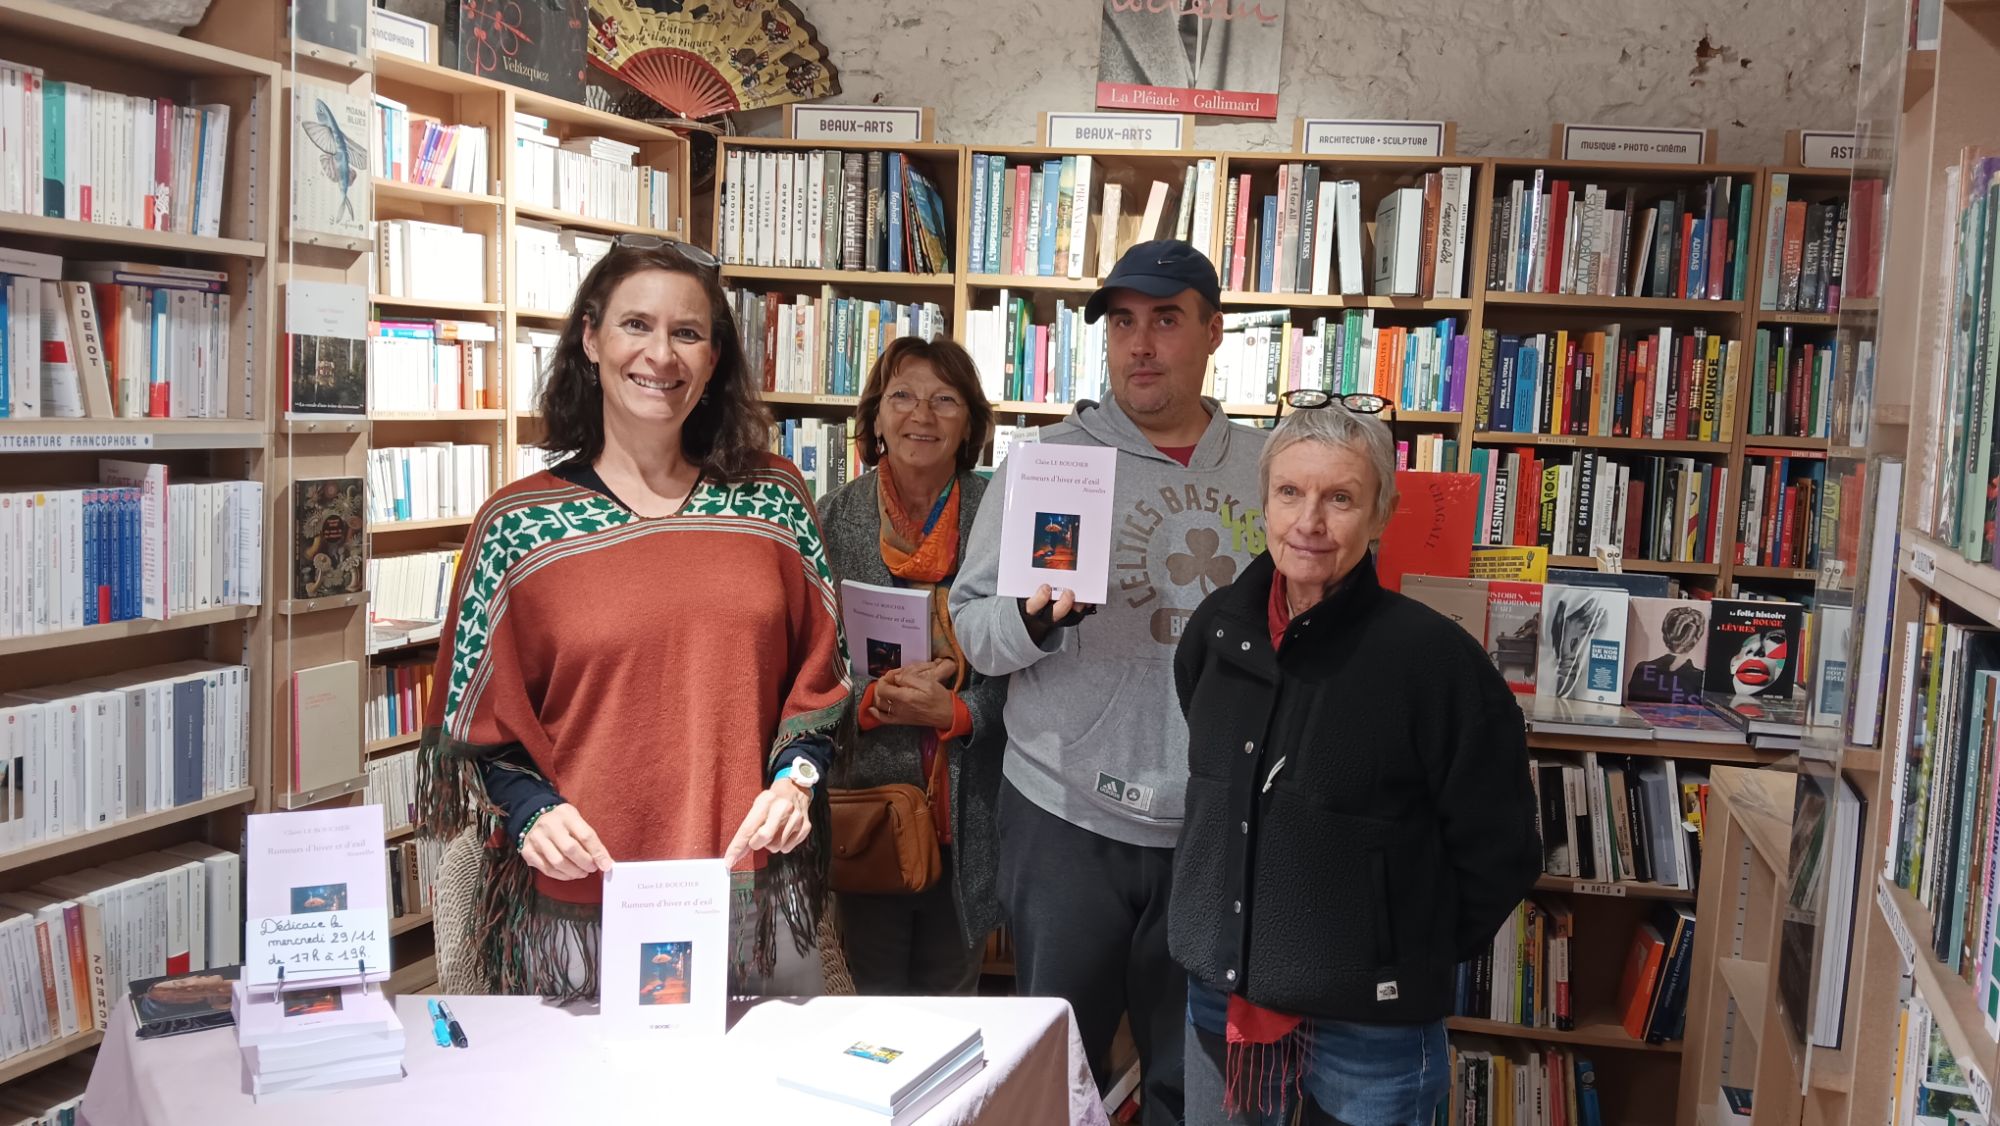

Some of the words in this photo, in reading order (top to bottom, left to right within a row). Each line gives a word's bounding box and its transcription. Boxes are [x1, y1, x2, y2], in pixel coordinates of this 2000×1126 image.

[502, 55, 550, 82] Velázquez
[345, 106, 367, 118] MOANA
[1111, 88, 1129, 103] La
[1133, 90, 1180, 107] Pléiade
[1193, 93, 1260, 113] Gallimard
[1305, 199, 1314, 226] SMALL
[972, 249, 981, 262] LE
[1690, 236, 1700, 271] ADIDAS
[76, 284, 98, 367] DIDEROT
[837, 308, 847, 353] BONNARD
[1703, 357, 1719, 422] GRUNGE
[1665, 391, 1678, 431] METAL
[70, 436, 137, 447] FRANCOPHONE
[1577, 453, 1593, 526] CHRONORAMA
[1490, 477, 1507, 542] FÉMINISTE
[1739, 500, 1747, 531] MERCEDES
[1116, 499, 1163, 609] CELTICS
[1159, 484, 1241, 520] BASK
[1721, 622, 1756, 633] LÈVRES
[1736, 609, 1755, 618] folle
[1755, 610, 1786, 620] histoire
[1752, 618, 1783, 628] ROUGE
[260, 918, 326, 936] Dédicace
[267, 929, 325, 948] mercredi
[330, 930, 376, 945] 29/11
[267, 953, 285, 966] de
